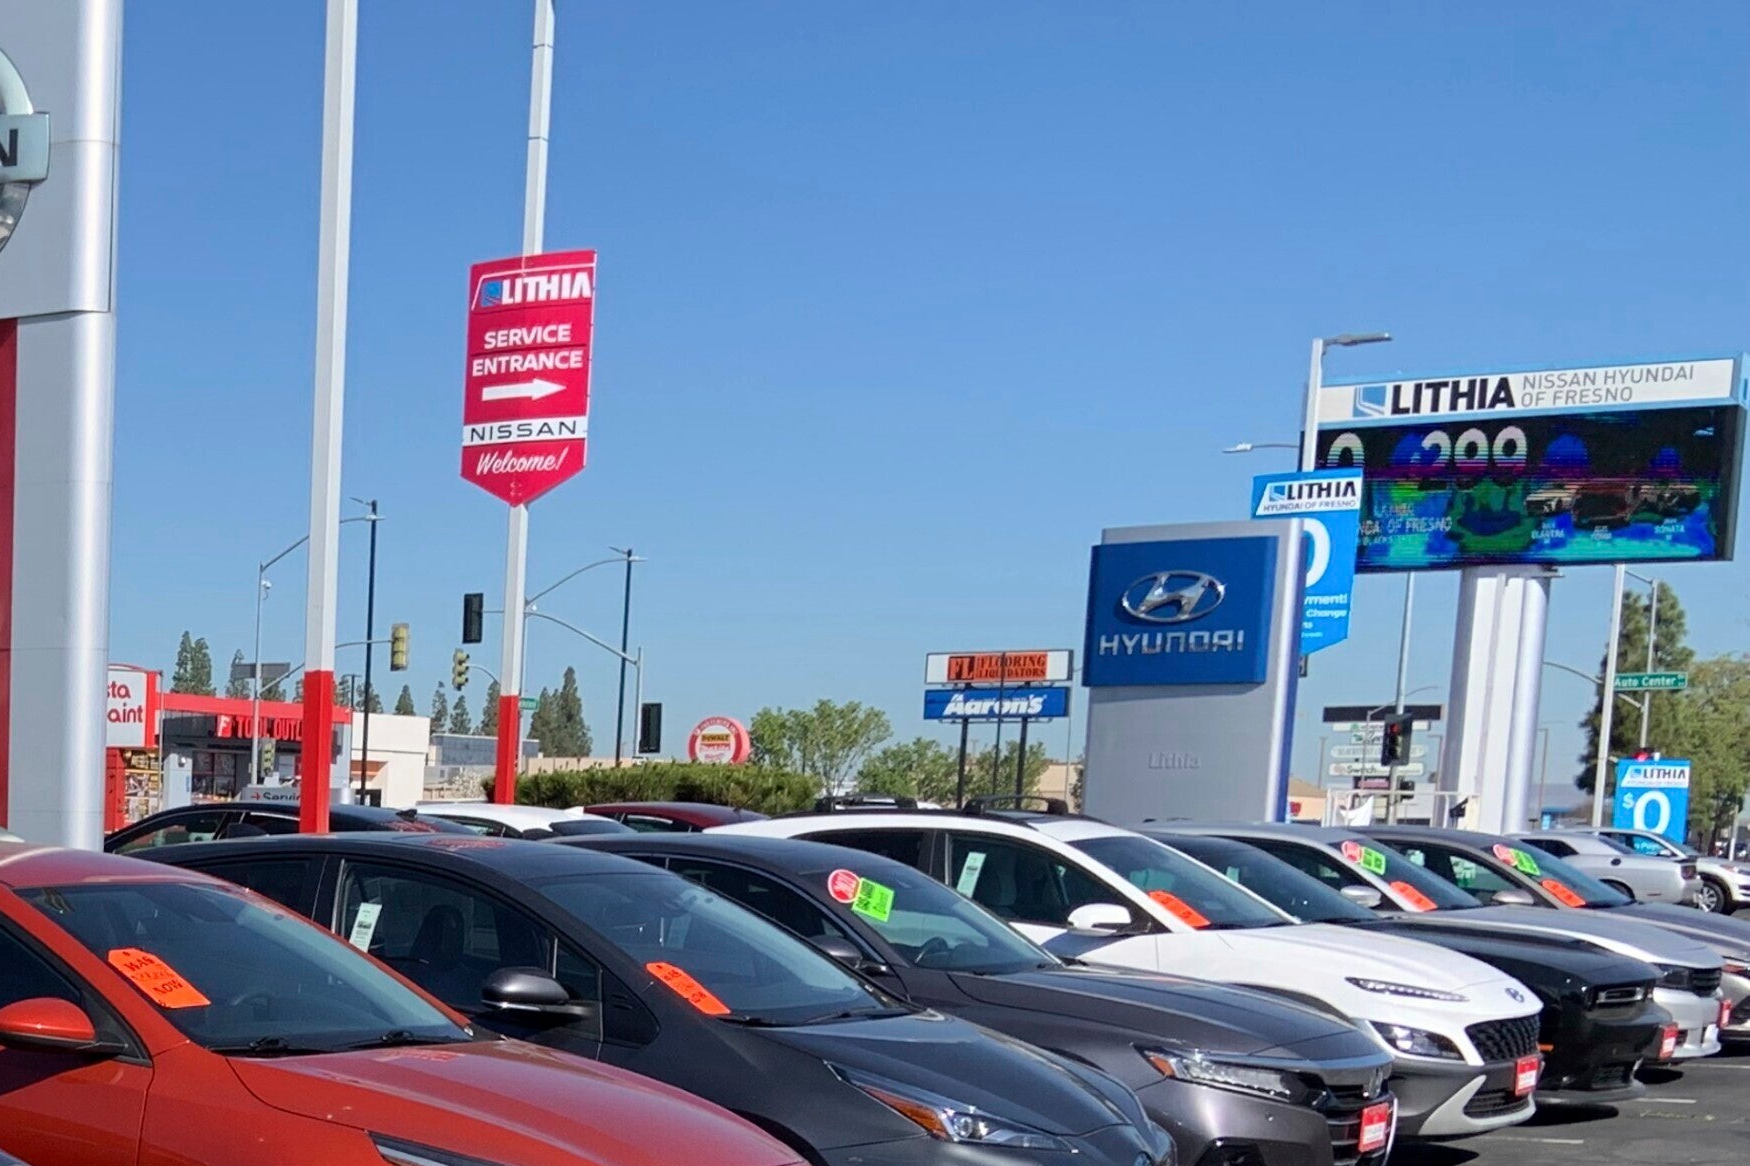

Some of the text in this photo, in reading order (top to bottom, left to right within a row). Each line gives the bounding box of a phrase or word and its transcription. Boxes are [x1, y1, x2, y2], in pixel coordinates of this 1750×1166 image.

[501, 271, 592, 305] LITHIA
[483, 324, 572, 349] SERVICE
[472, 350, 583, 377] ENTRANCE
[1522, 365, 1694, 391] NISSAN HYUNDAI
[1391, 376, 1516, 415] LITHIA
[1521, 386, 1633, 407] OF FRESNO
[470, 420, 577, 442] NISSAN
[476, 446, 570, 476] Welcome!
[1286, 481, 1356, 500] LITHIA
[1263, 501, 1303, 513] HYUNDAI
[1318, 499, 1357, 509] FRESNO
[1099, 629, 1245, 656] HYUNDAI
[978, 667, 1047, 679] LIQUDATORS
[1614, 676, 1639, 688] Auto
[1641, 675, 1677, 687] Center
[942, 693, 1047, 716] Aaron's
[1643, 768, 1687, 780] LITHIA
